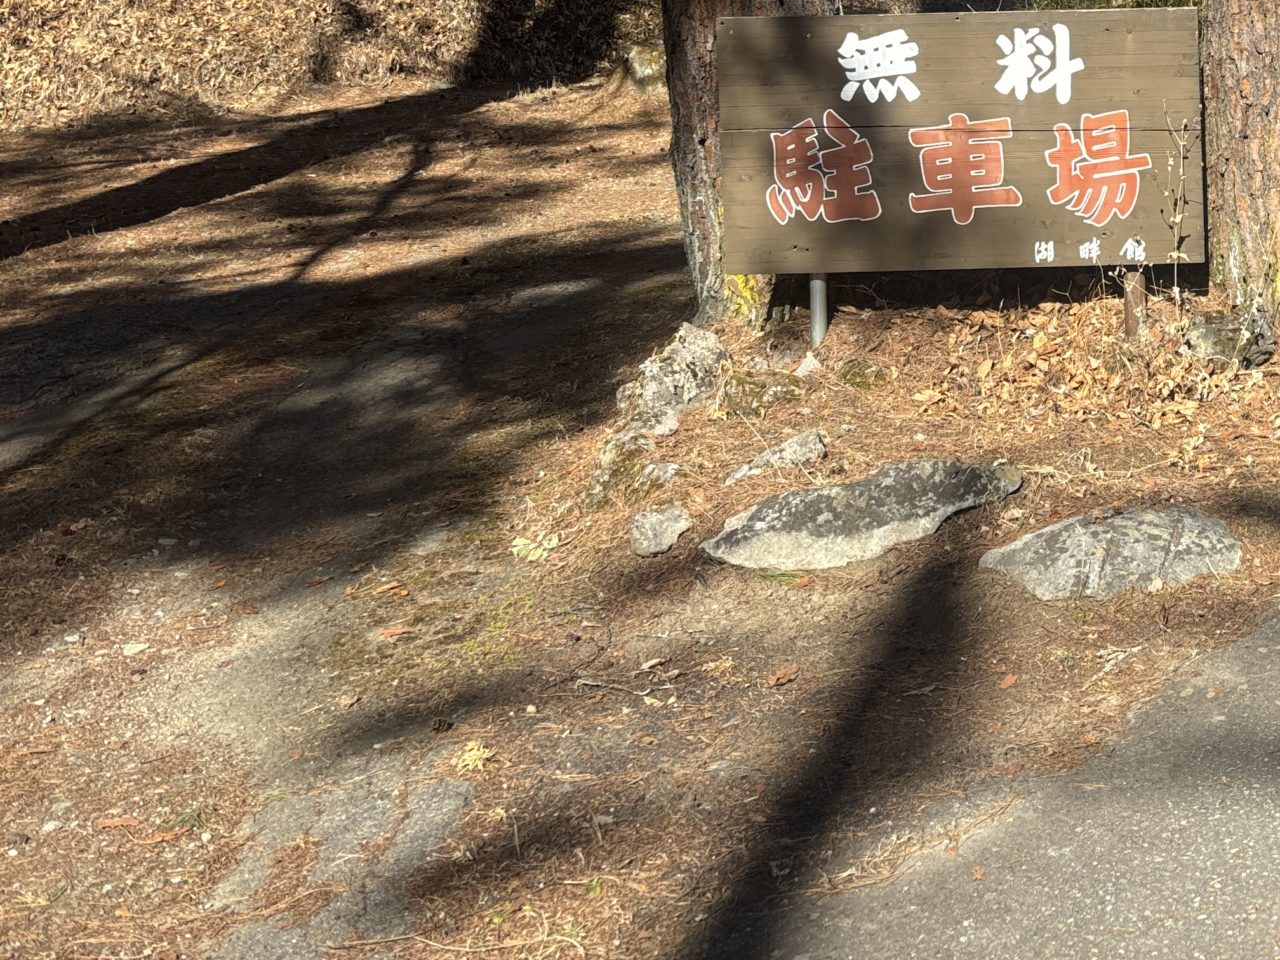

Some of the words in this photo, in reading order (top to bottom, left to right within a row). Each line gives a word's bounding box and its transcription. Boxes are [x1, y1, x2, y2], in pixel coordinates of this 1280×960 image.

[837, 24, 1085, 104] 無料
[766, 109, 1152, 227] 駐車場
